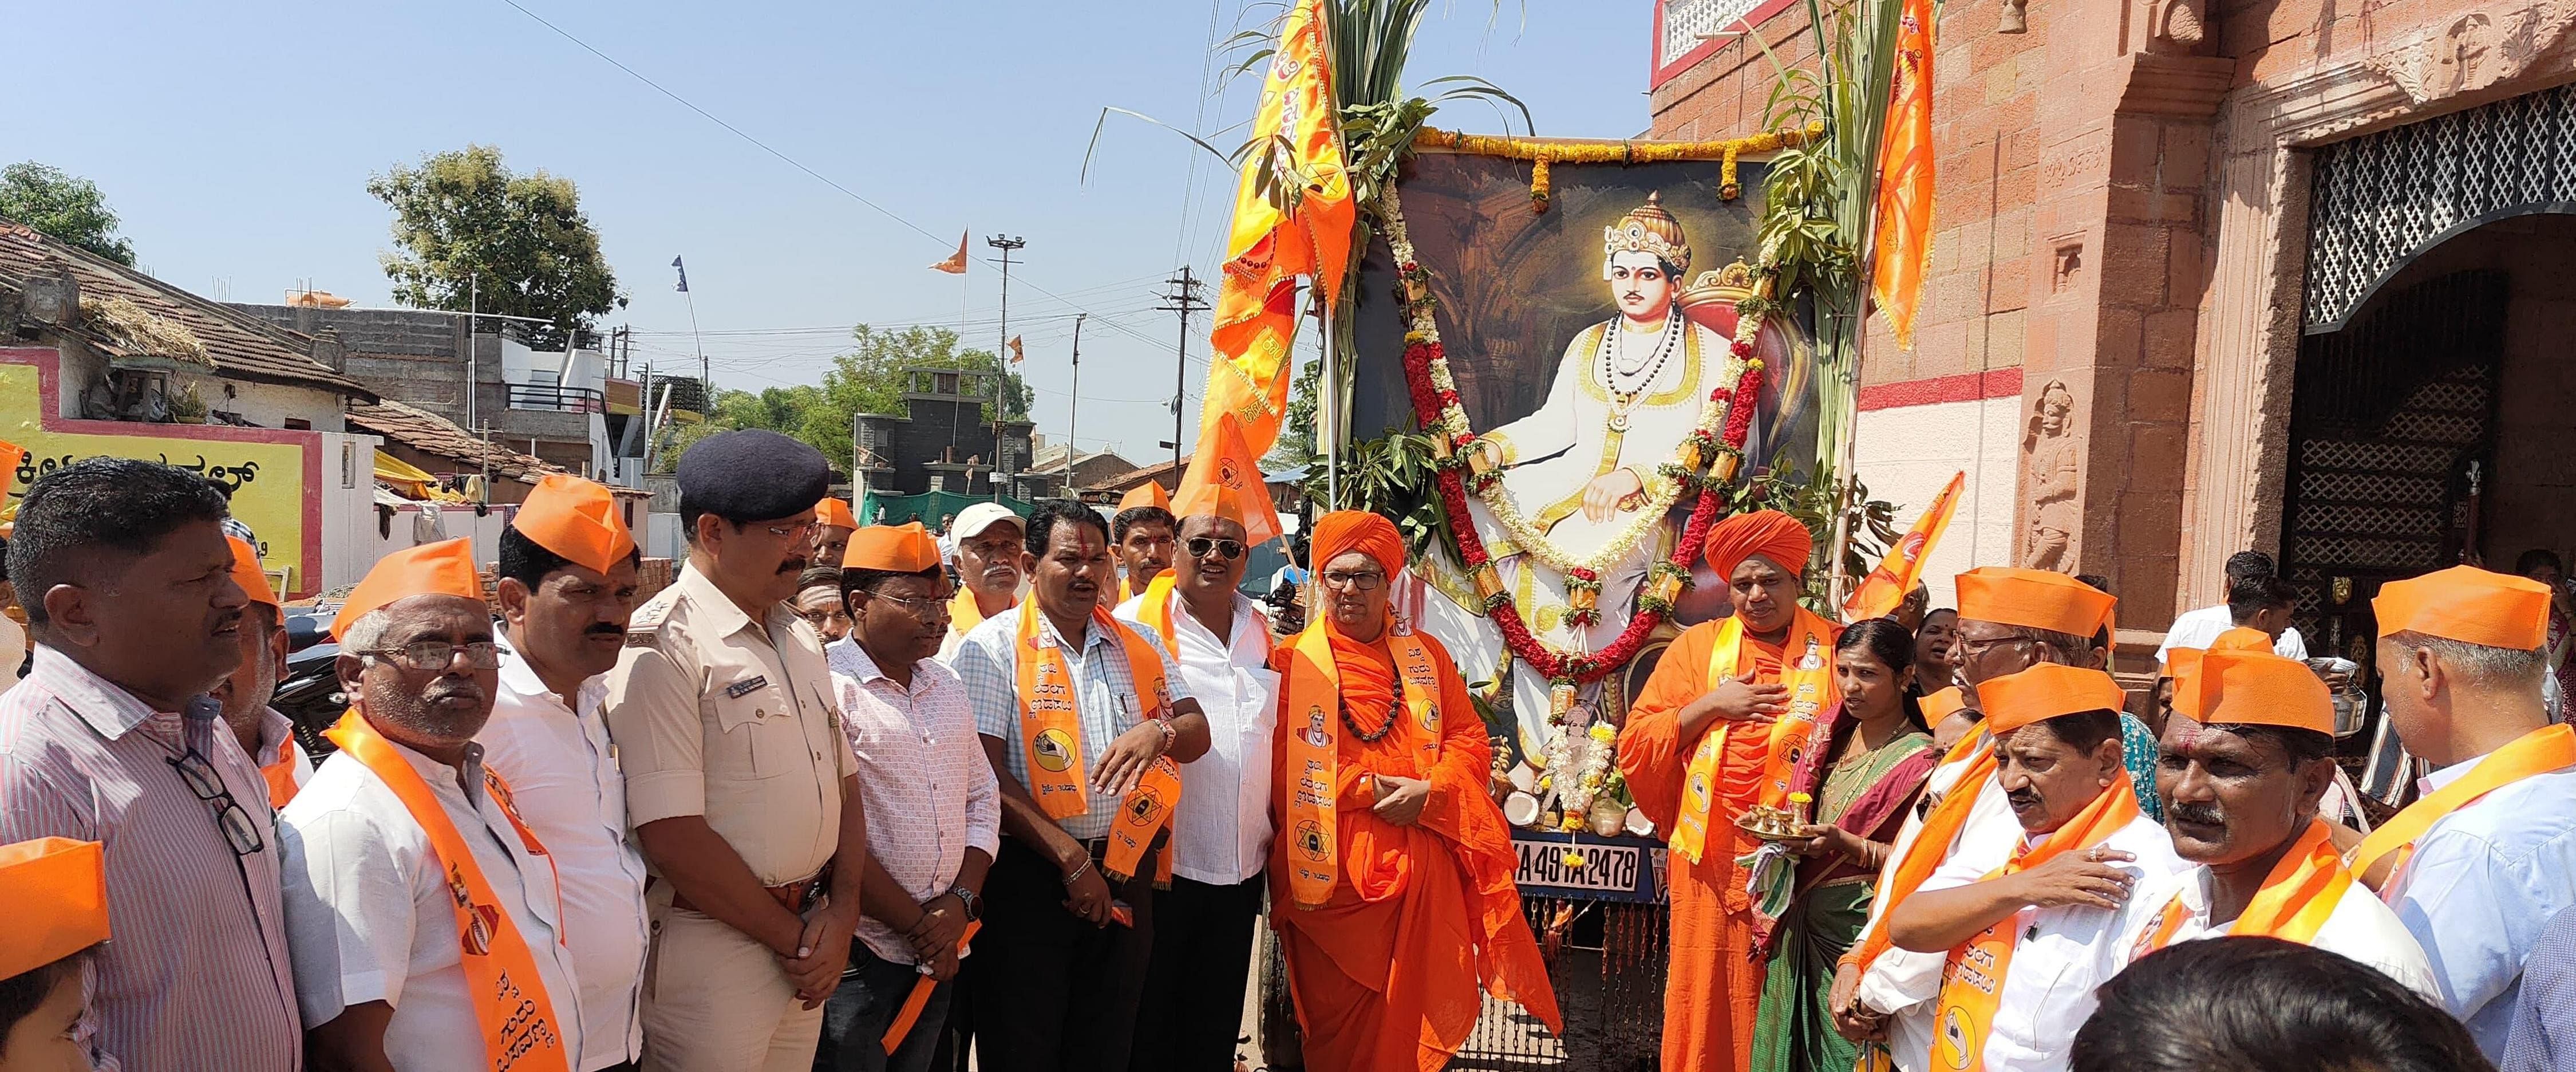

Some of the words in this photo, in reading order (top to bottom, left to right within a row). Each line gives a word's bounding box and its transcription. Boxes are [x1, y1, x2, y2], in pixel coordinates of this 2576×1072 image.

[1408, 647, 1426, 661] ವಿಶ್ವ
[1408, 664, 1431, 674] ಗುರು
[500, 999, 536, 1045] ಗುರು
